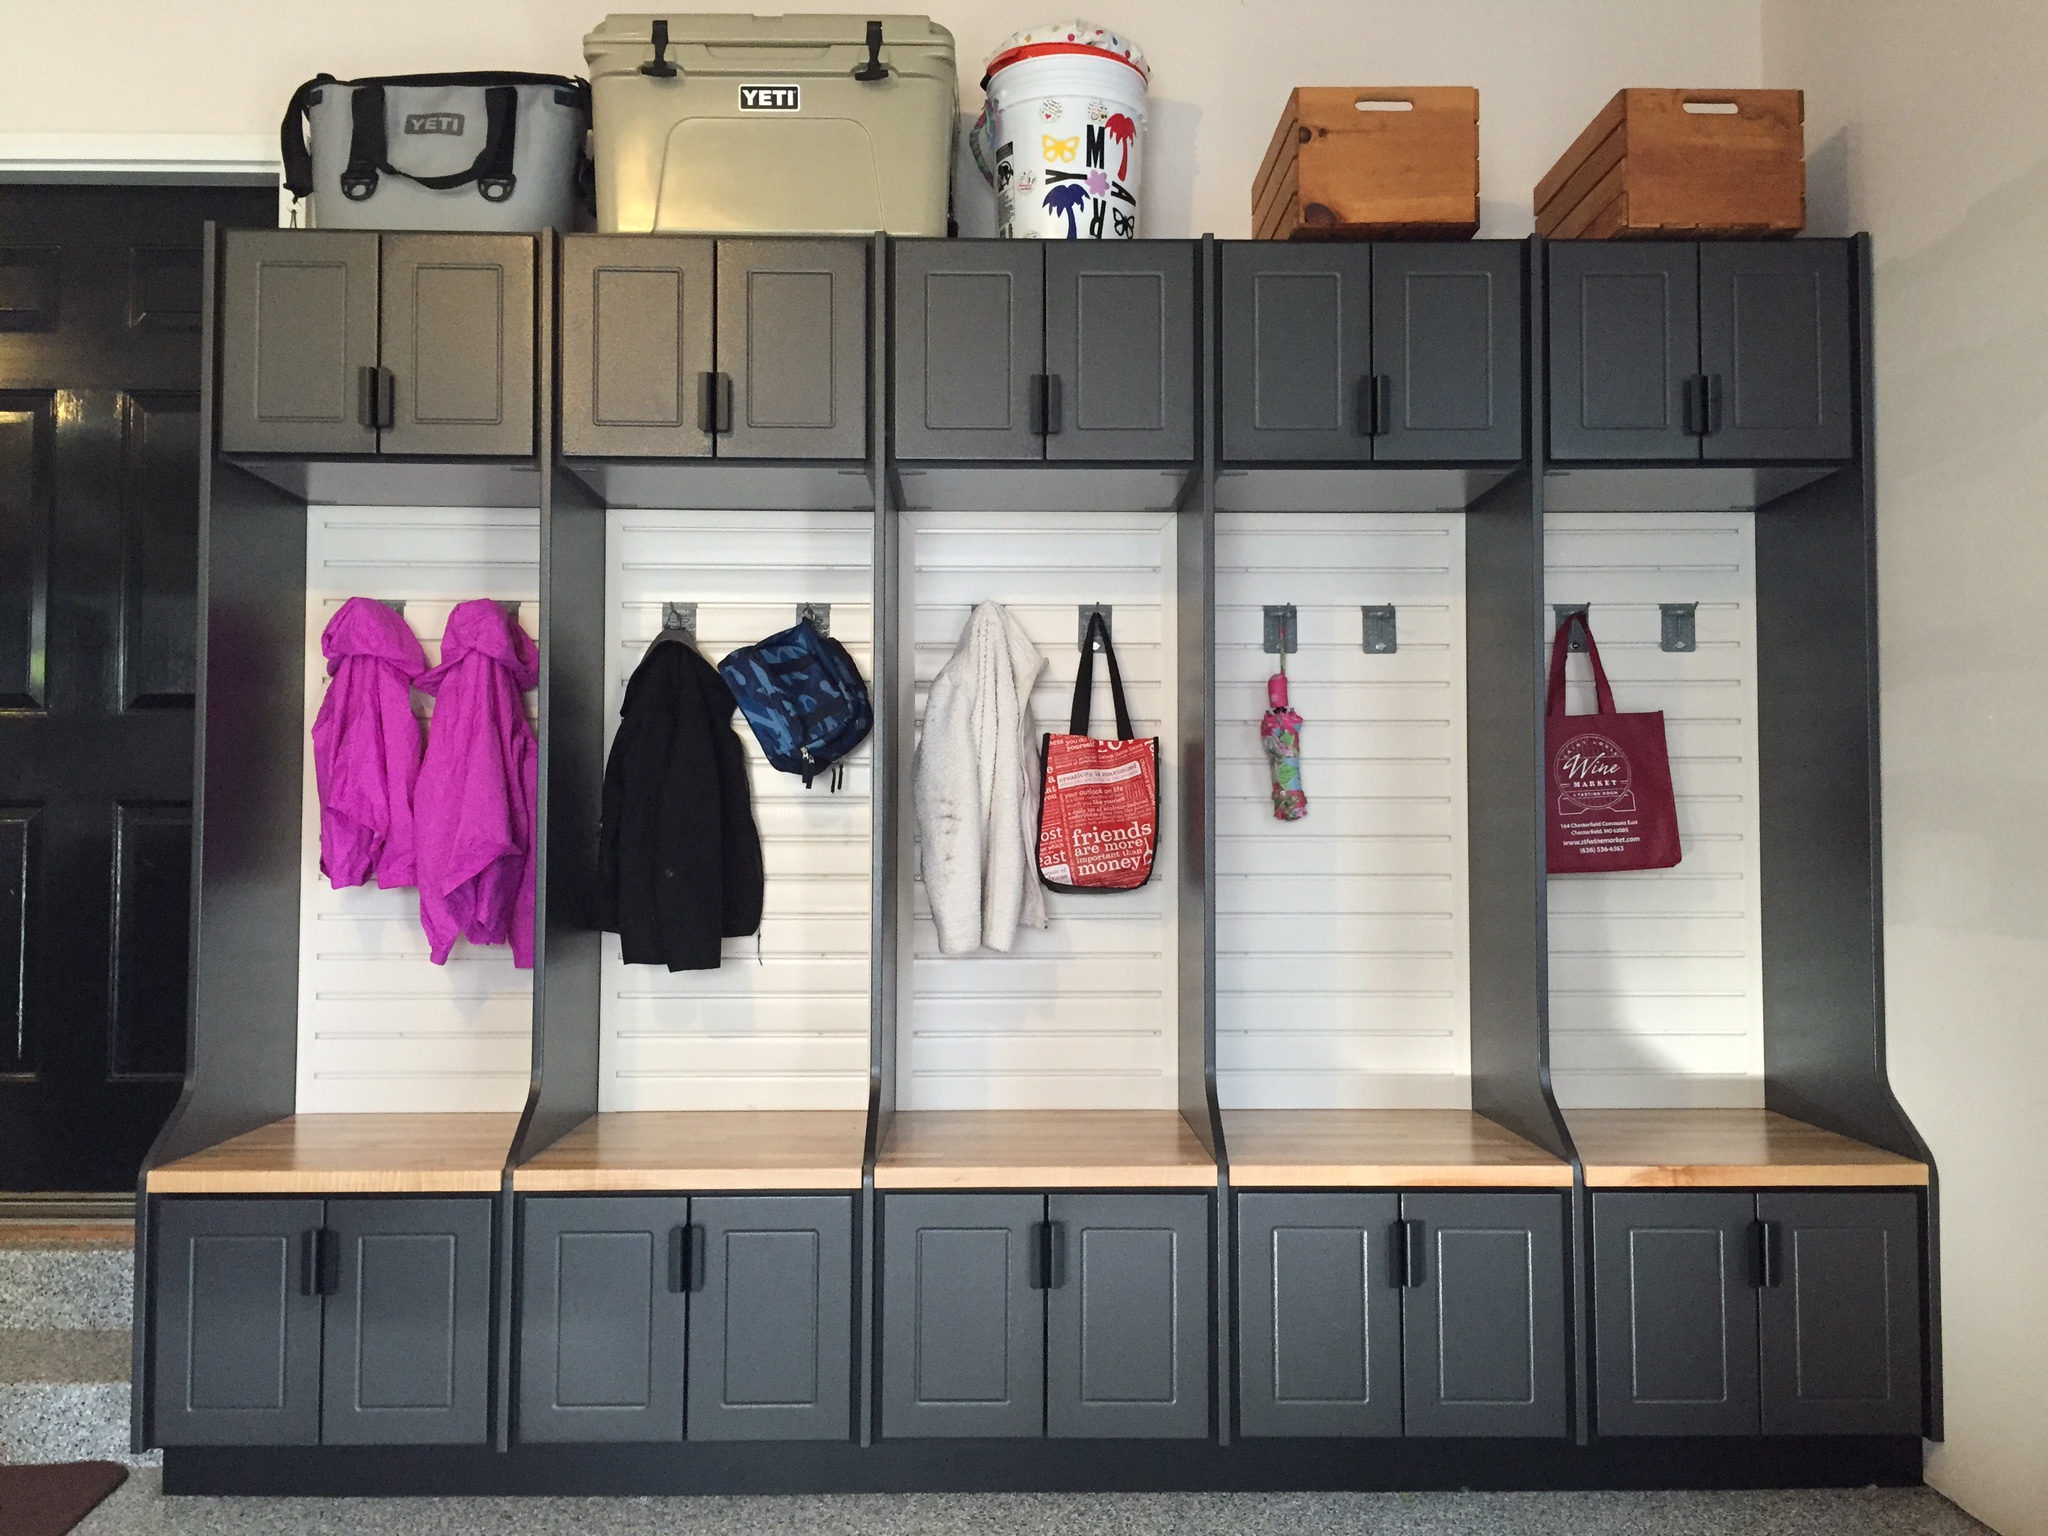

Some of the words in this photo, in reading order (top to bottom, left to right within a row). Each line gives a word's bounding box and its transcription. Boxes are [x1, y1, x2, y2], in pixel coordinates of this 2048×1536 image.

[742, 90, 794, 106] YETI
[411, 117, 459, 132] YETI
[1086, 124, 1105, 169] M
[1562, 752, 1621, 779] Wine
[1059, 771, 1093, 782] creativity
[1573, 779, 1617, 788] MARKET
[1079, 787, 1103, 796] outlook
[1072, 821, 1152, 847] friends
[1074, 844, 1100, 857] are
[1104, 838, 1143, 852] more
[1076, 851, 1121, 864] important
[1122, 848, 1143, 857] than
[1077, 855, 1142, 876] money
